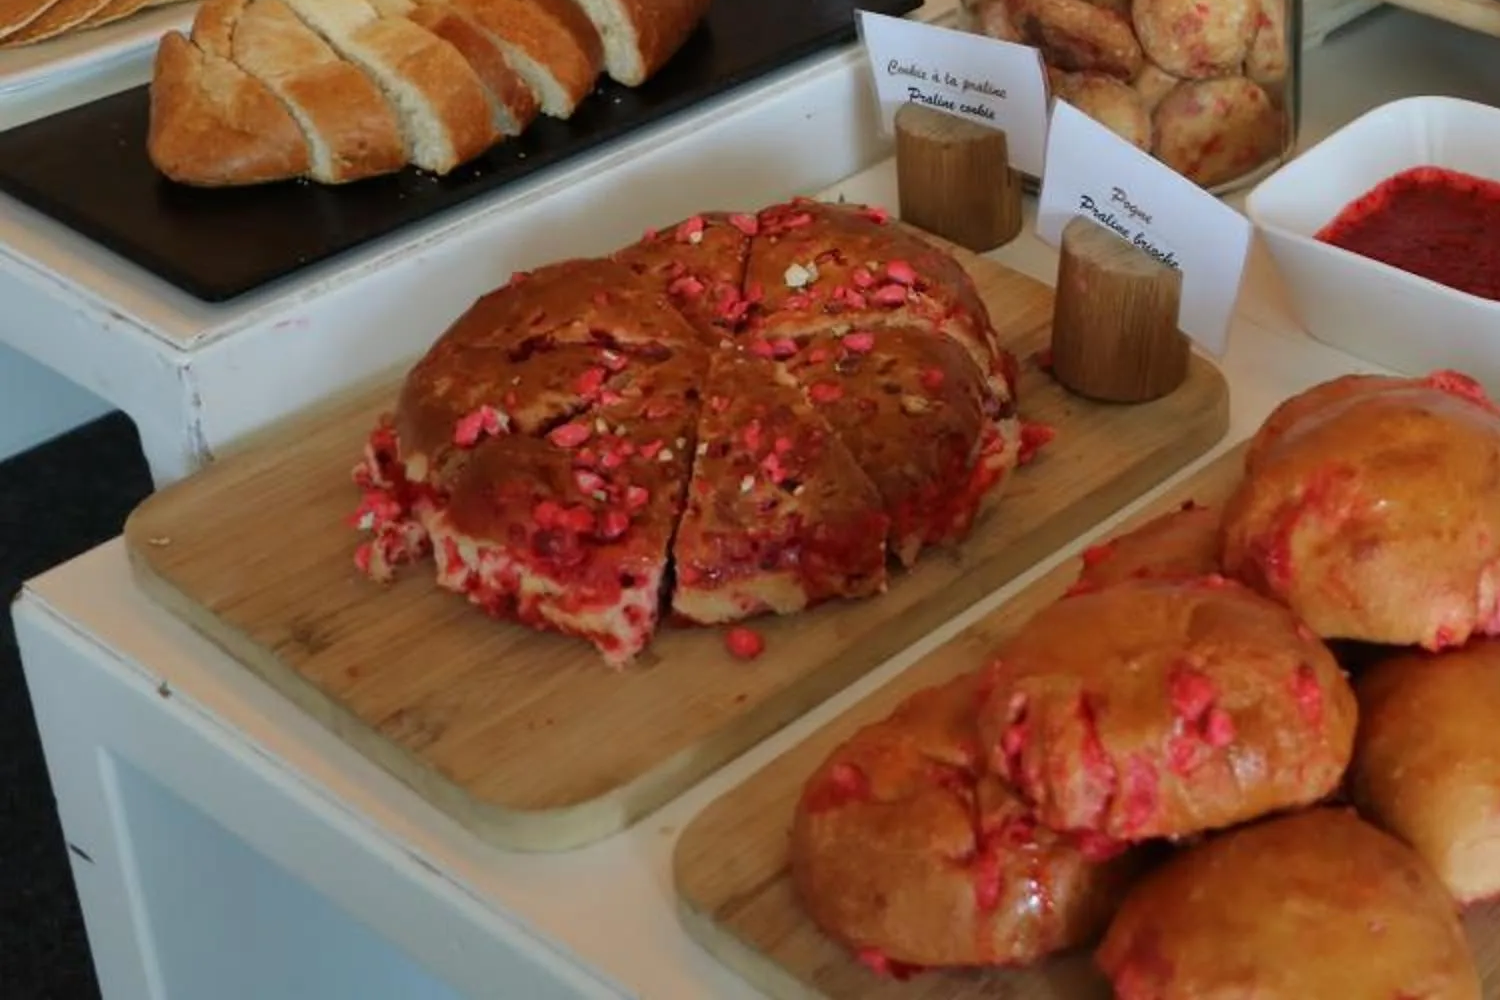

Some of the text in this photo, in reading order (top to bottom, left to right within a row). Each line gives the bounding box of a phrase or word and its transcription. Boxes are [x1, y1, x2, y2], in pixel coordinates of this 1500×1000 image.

[945, 71, 959, 87] la
[962, 79, 1008, 100] praline
[907, 86, 996, 120] Praline cookie
[1079, 194, 1180, 268] Praline brioche
